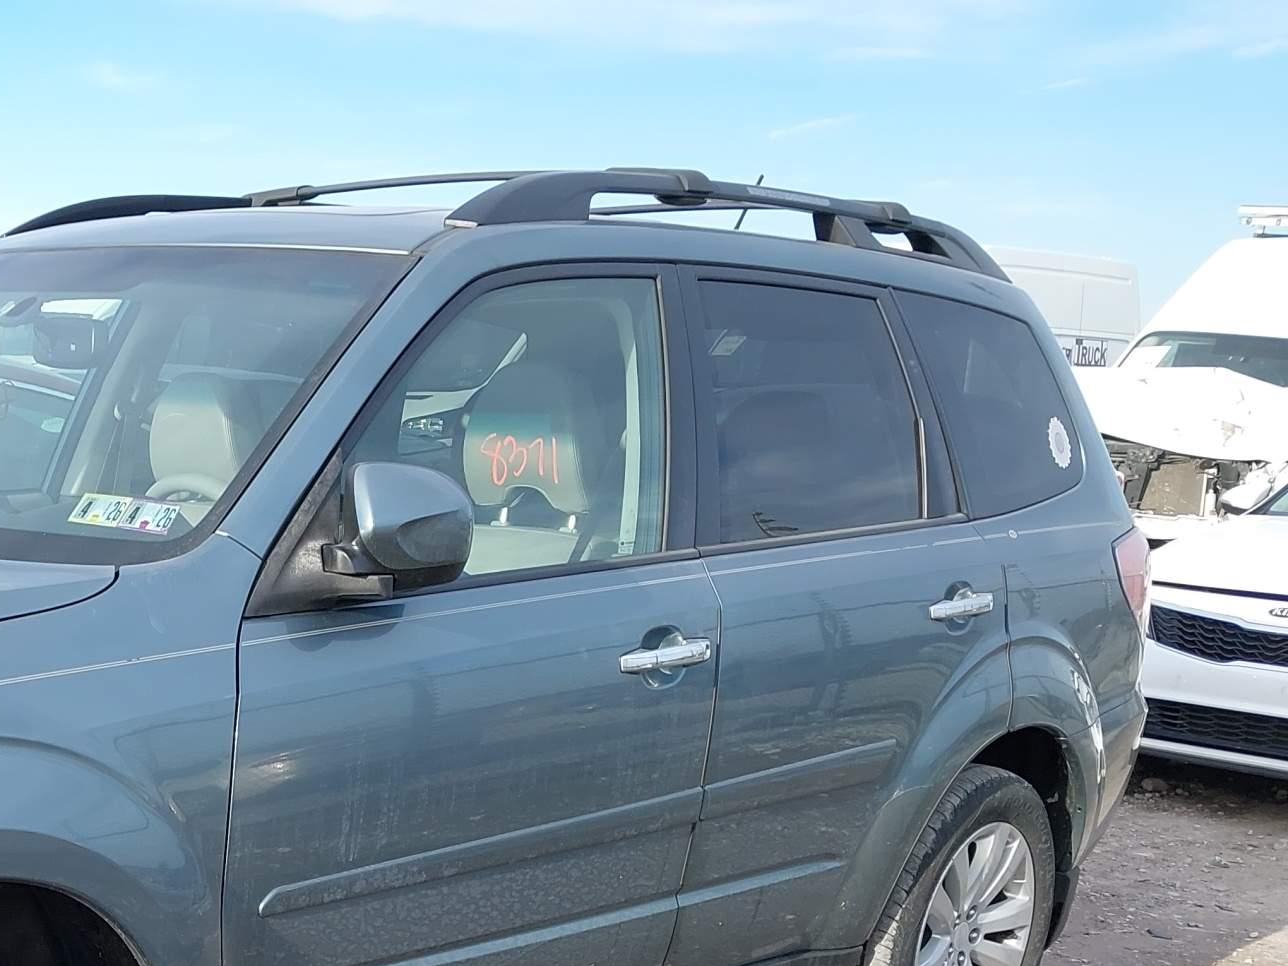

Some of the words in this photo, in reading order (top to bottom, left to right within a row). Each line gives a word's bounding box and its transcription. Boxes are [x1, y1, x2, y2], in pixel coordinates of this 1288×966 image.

[480, 432, 559, 486] 8371
[105, 500, 128, 522] 26
[156, 507, 178, 529] 26
[1271, 608, 1288, 617] KI
